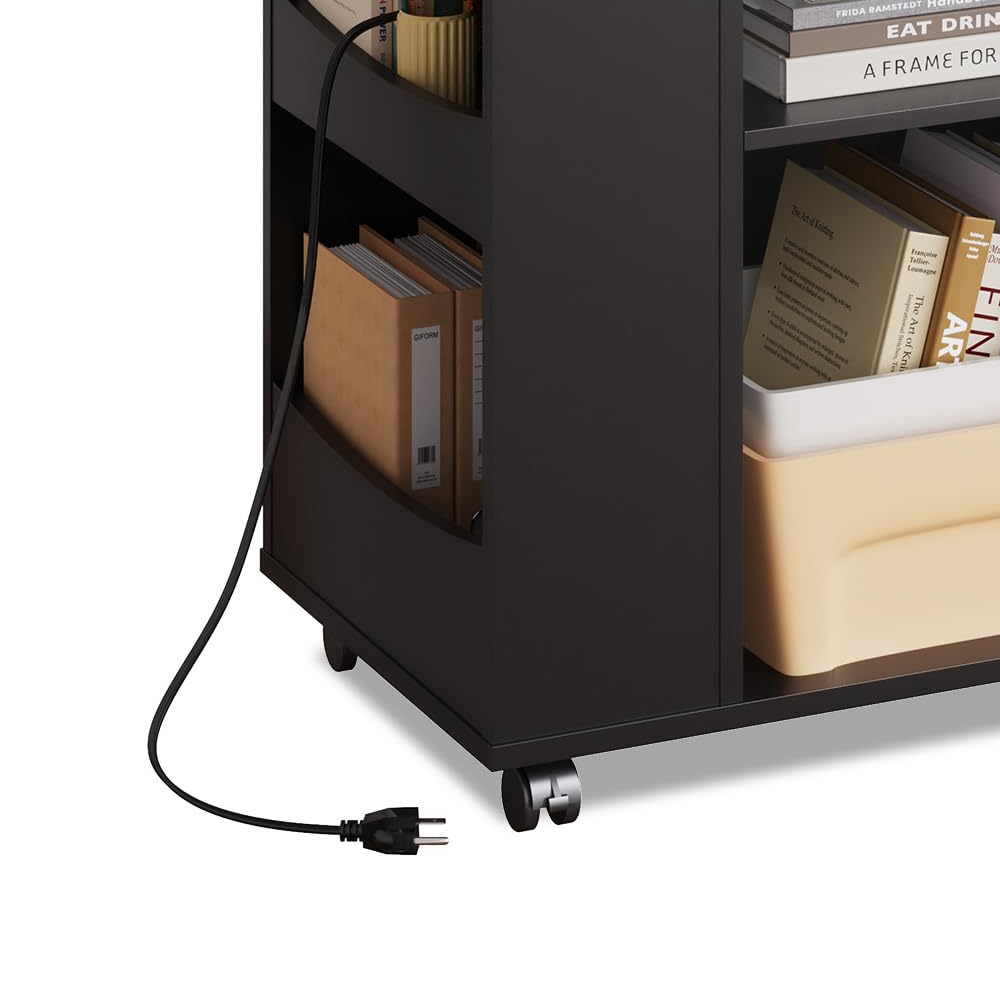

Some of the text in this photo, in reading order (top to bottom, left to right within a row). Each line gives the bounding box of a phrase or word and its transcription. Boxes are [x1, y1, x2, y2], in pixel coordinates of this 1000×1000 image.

[836, 7, 866, 18] FRIDA
[869, 1, 922, 14] RAMSTEDT
[887, 20, 932, 39] EAT
[863, 63, 876, 79] A
[882, 52, 953, 77] FRAME
[960, 47, 997, 67] FOR
[912, 295, 925, 315] The
[908, 317, 919, 335] Art
[413, 331, 439, 341] GIFORM
[905, 337, 913, 350] of
[937, 311, 968, 364] AR
